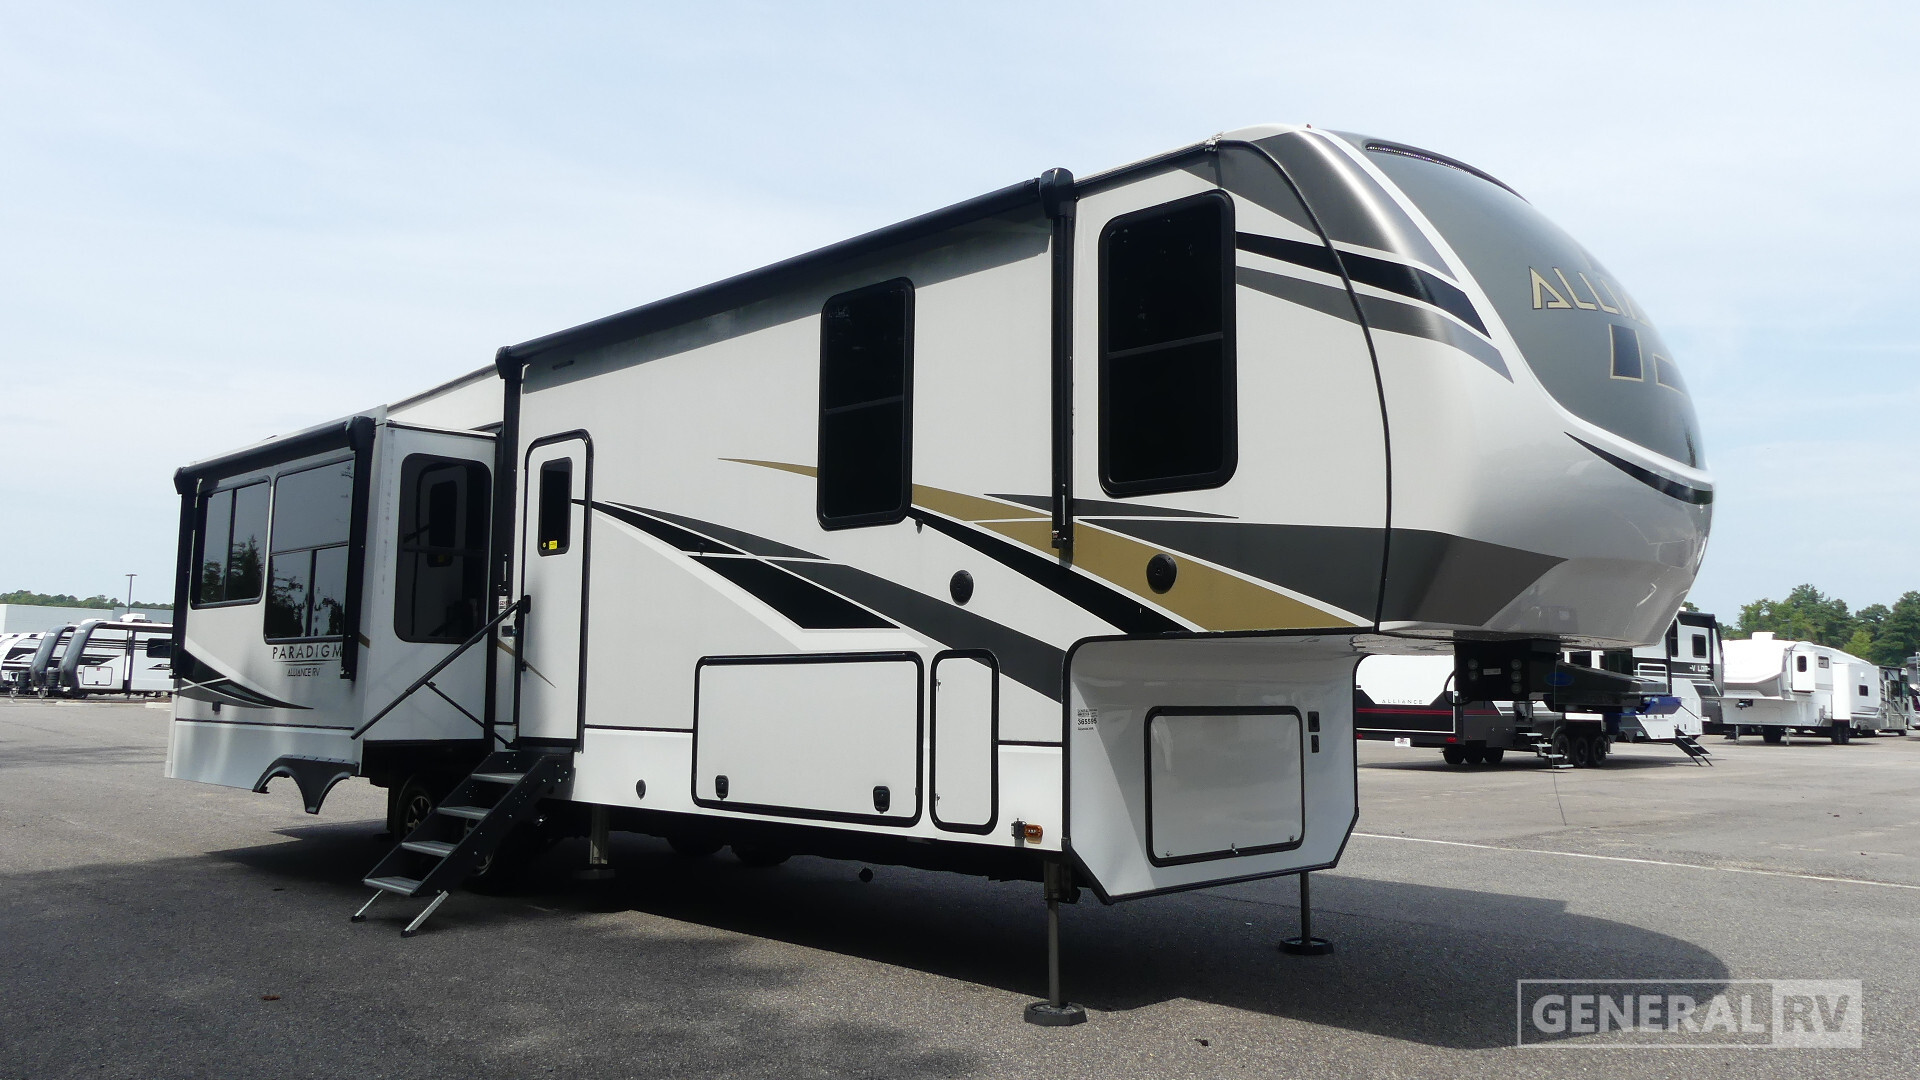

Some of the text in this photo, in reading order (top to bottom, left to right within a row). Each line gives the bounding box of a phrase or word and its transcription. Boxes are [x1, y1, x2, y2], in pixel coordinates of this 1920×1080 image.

[272, 644, 342, 659] PARADIGM
[287, 668, 320, 677] ALLIANCE RV
